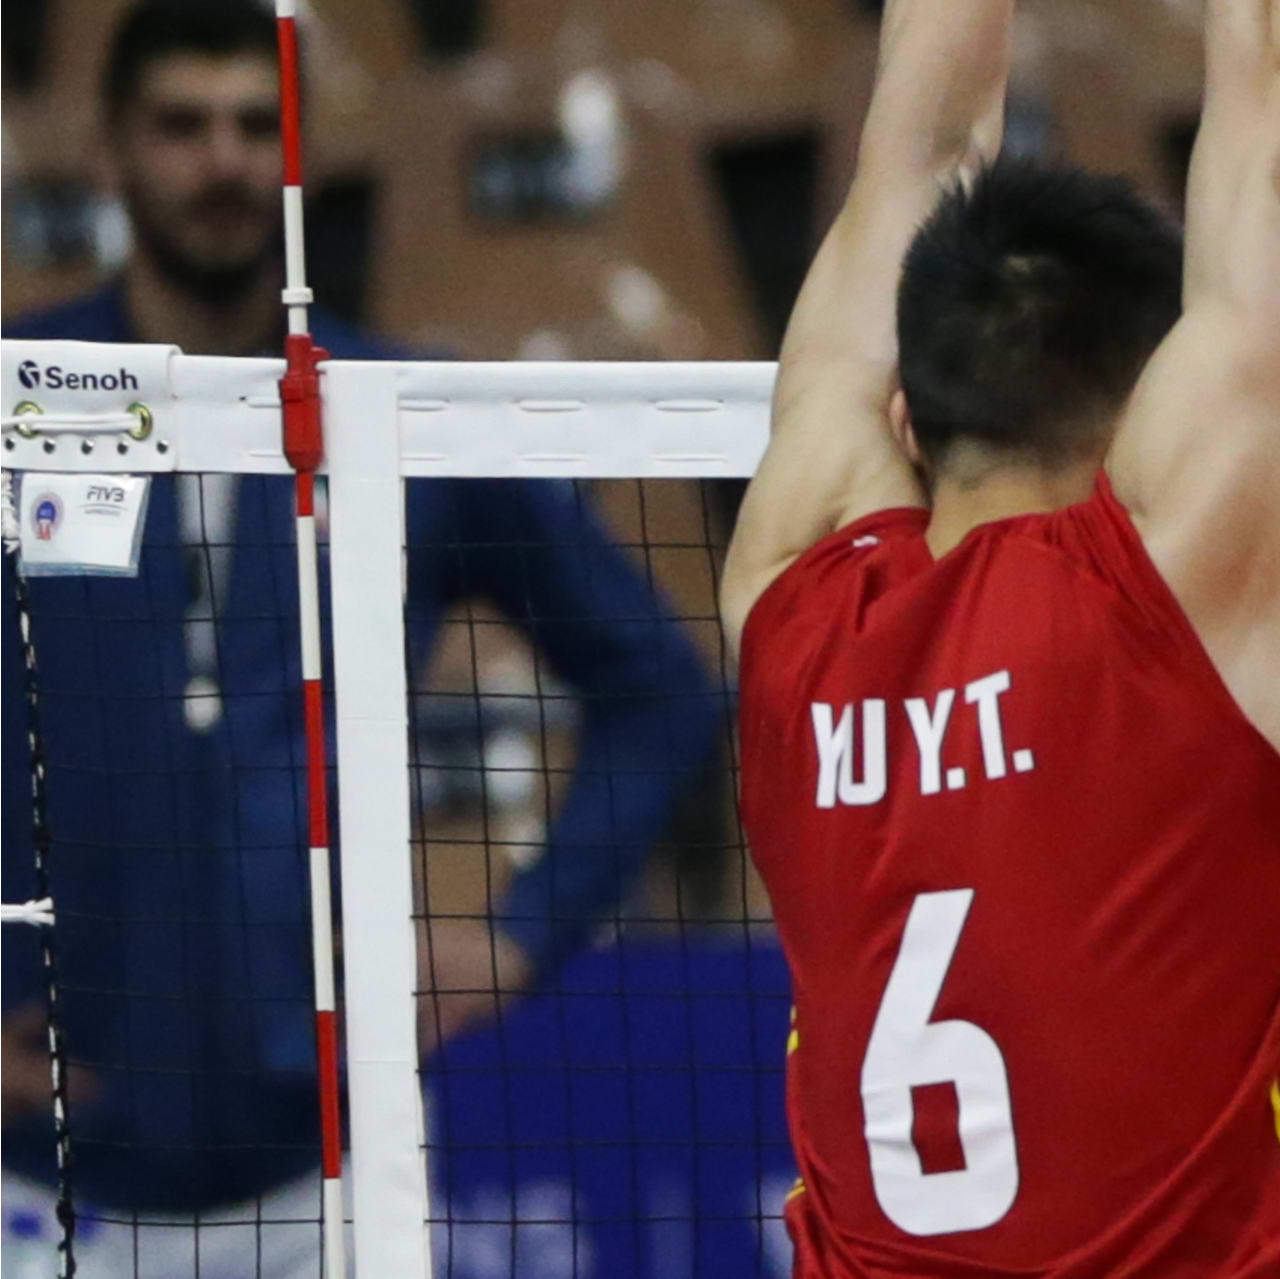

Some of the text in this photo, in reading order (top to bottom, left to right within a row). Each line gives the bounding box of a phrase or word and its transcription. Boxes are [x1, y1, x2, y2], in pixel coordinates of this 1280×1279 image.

[45, 366, 138, 391] Senoh
[810, 669, 1036, 809] YU Y.T.
[860, 888, 1020, 1237] 6
